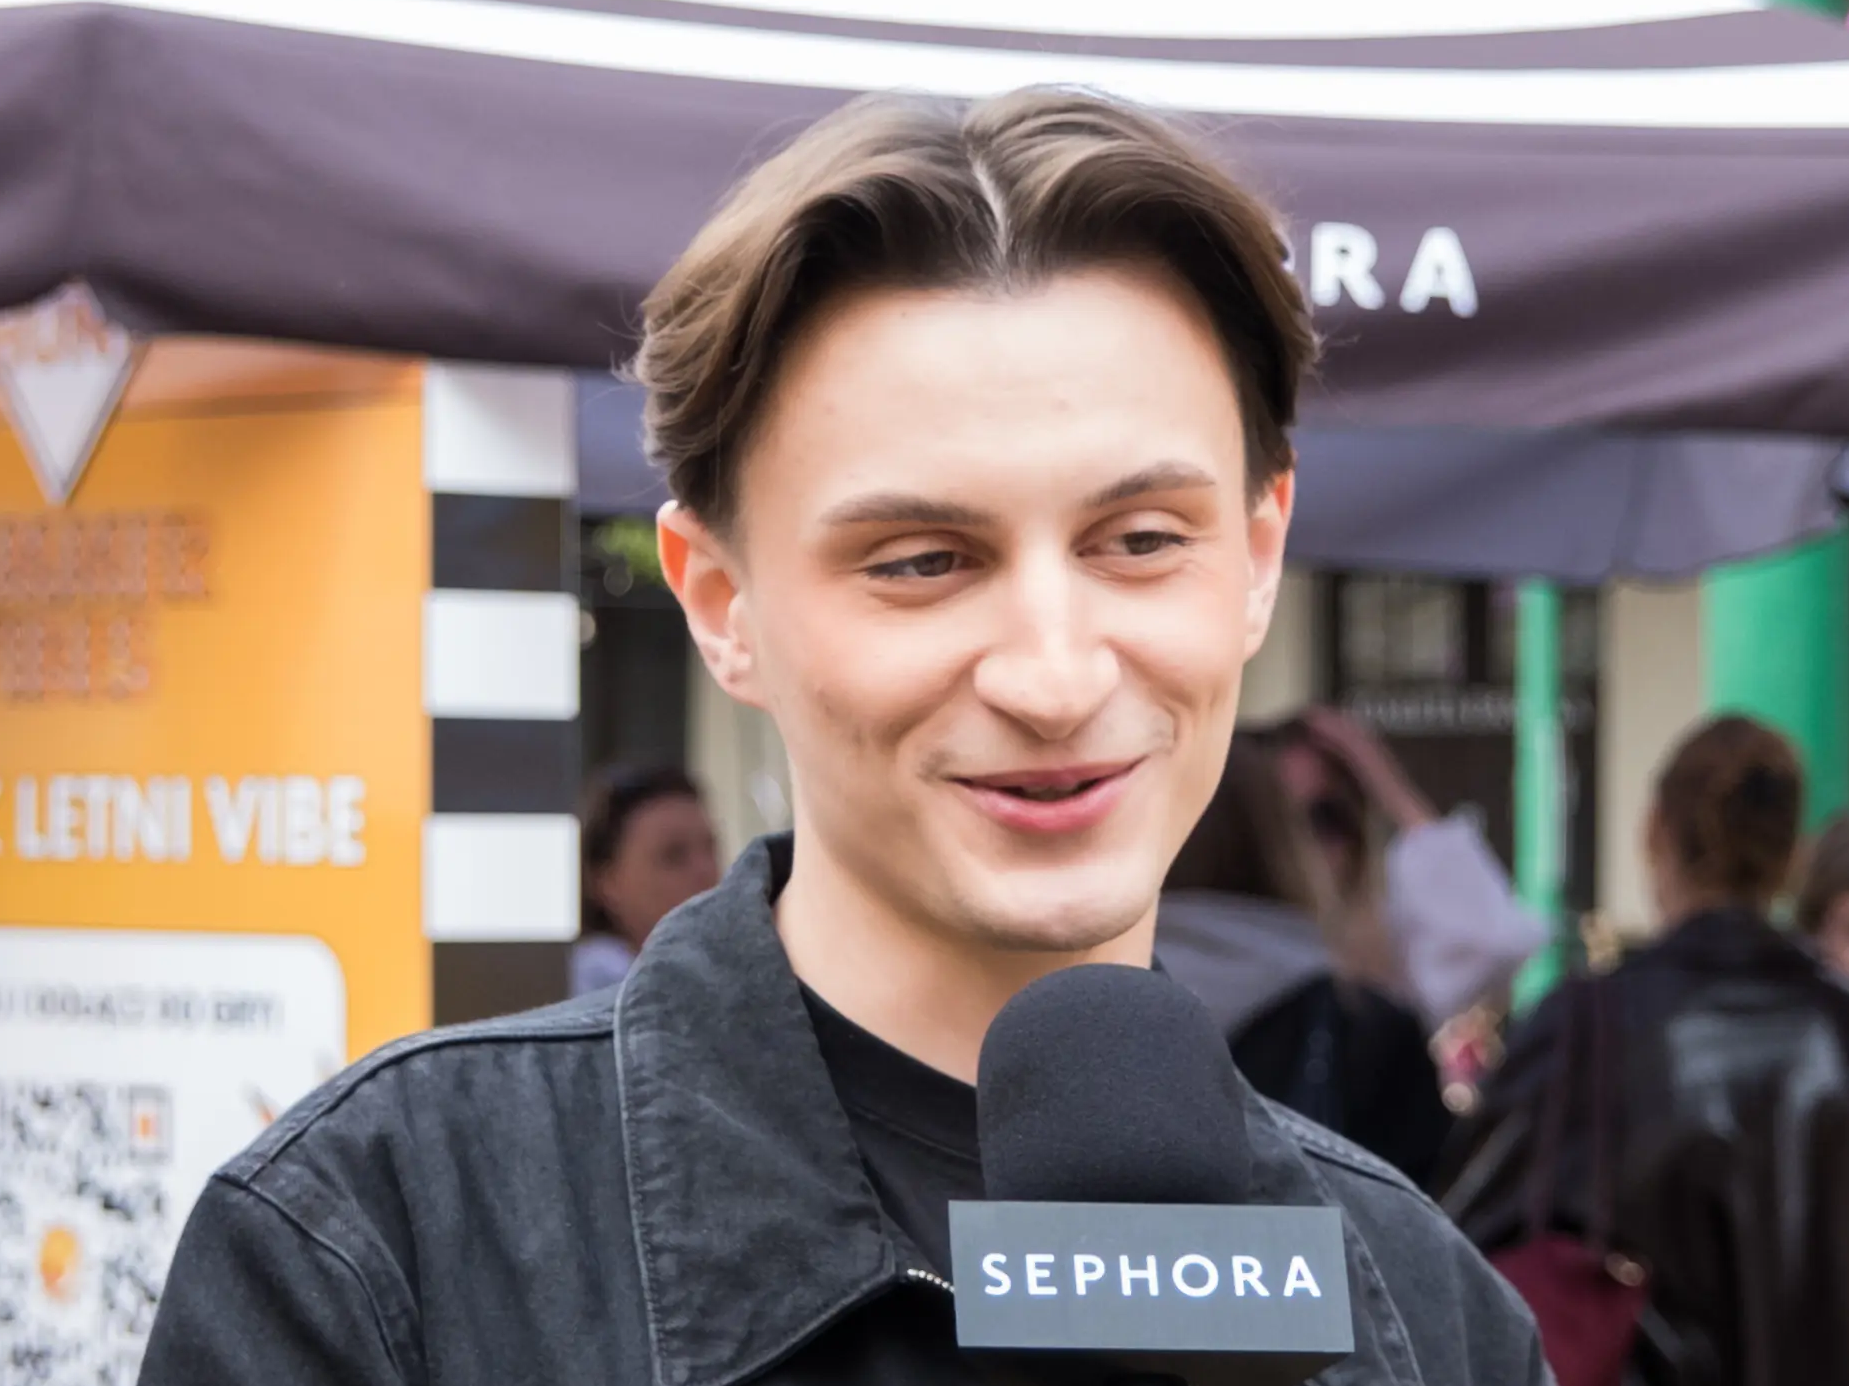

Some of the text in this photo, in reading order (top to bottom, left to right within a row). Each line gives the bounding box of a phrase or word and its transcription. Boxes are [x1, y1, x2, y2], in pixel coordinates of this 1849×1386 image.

[1280, 220, 1480, 319] RA
[15, 773, 193, 863] LETNI
[203, 773, 368, 868] VIBE
[980, 1251, 1323, 1299] SEPHORA
